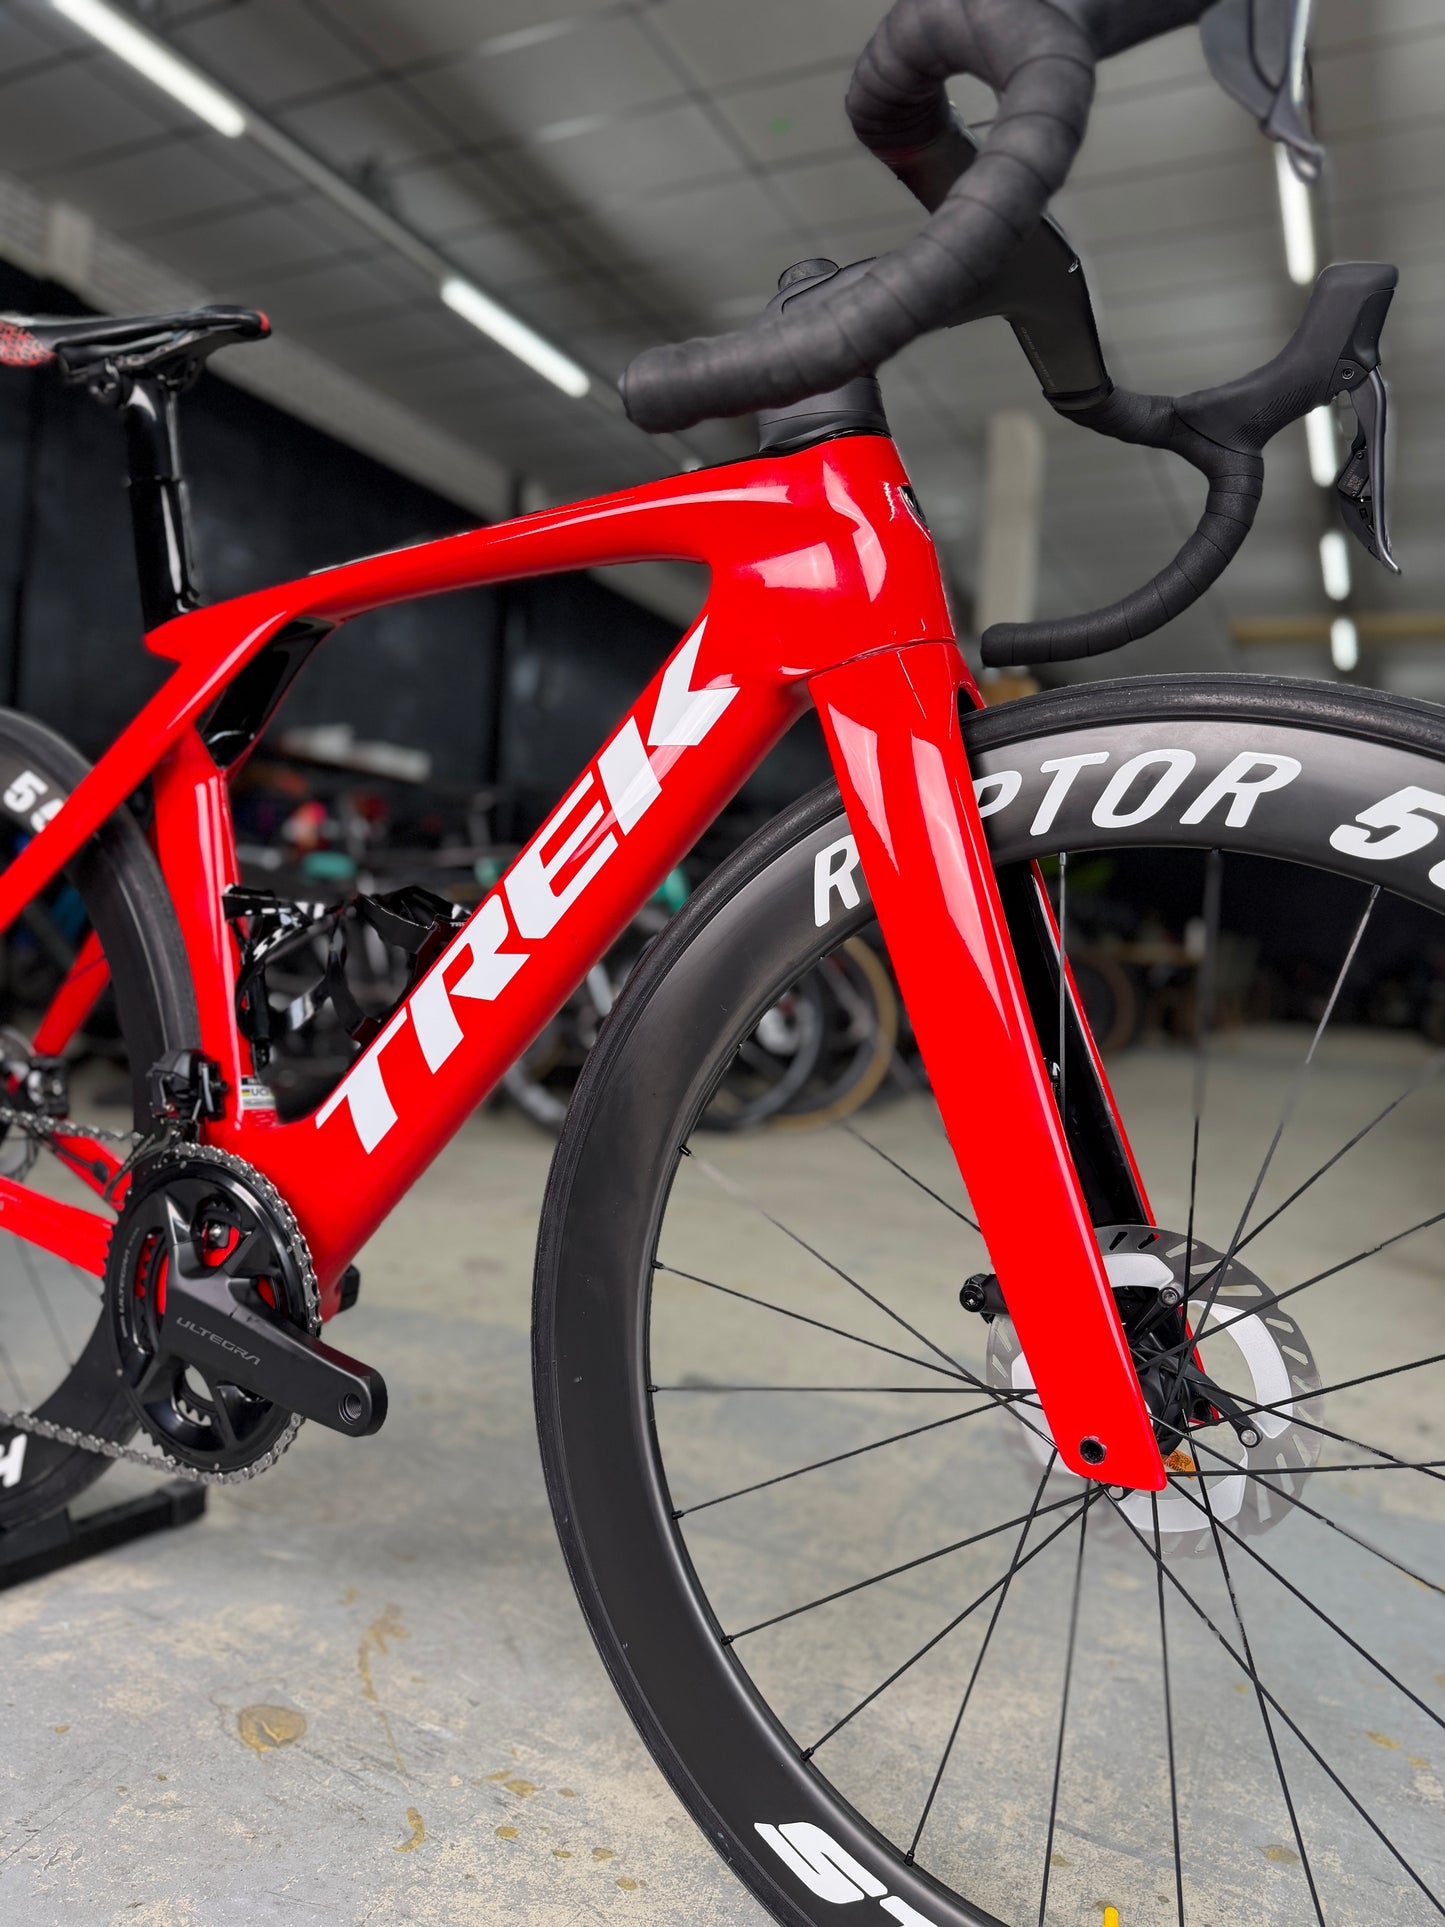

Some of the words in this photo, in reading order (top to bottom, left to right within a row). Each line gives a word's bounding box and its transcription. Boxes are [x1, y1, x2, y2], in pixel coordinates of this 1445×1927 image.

[315, 614, 741, 1155] TREK
[814, 748, 1302, 928] RPTOR
[1329, 785, 1445, 890] 5
[176, 1316, 261, 1366] ULTEGRA
